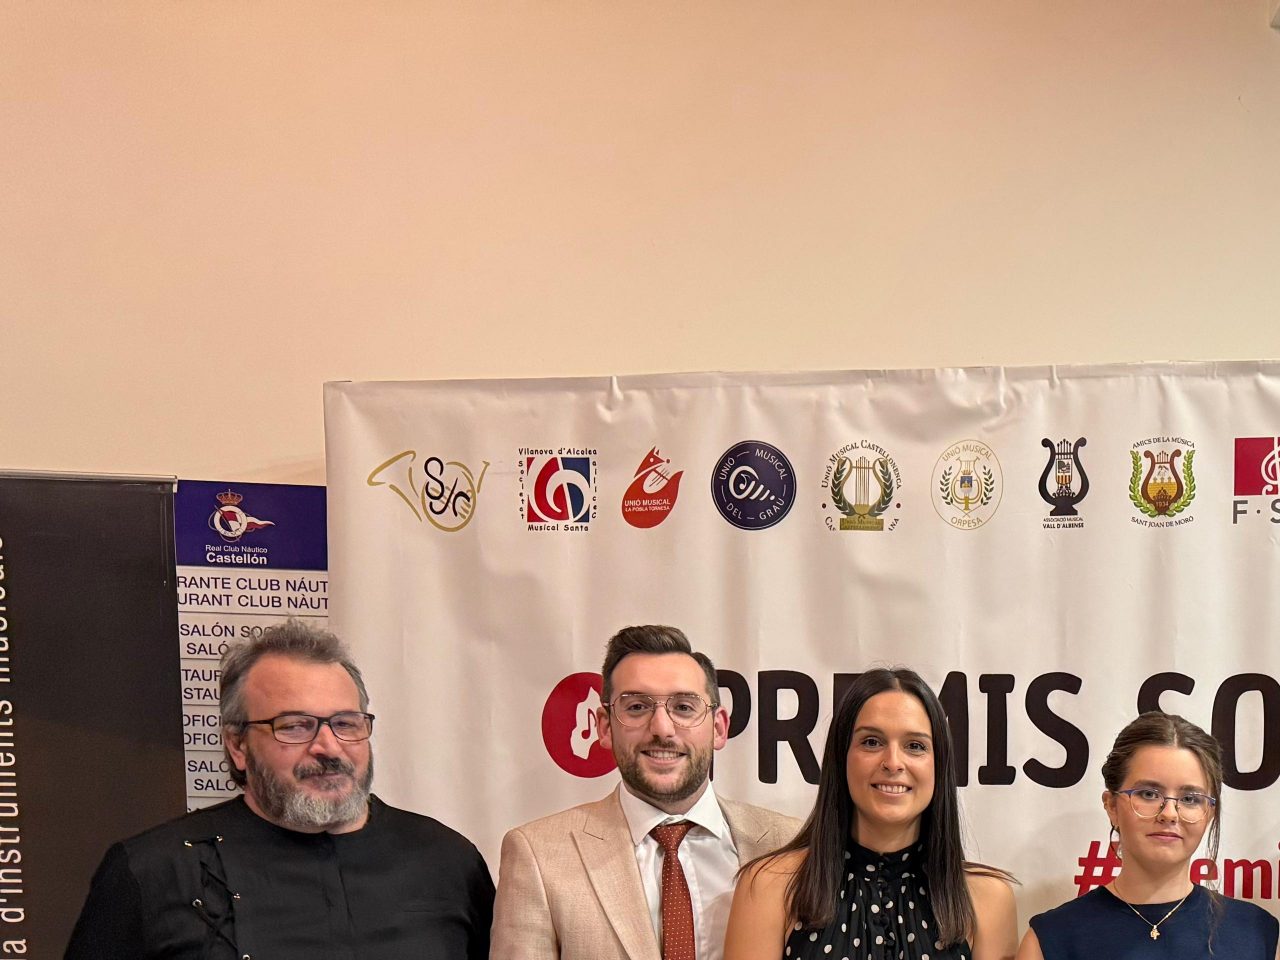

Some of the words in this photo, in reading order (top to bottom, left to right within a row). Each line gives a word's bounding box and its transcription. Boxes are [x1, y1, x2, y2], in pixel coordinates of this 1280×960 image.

[1132, 437, 1152, 449] AMICS
[518, 448, 554, 456] Vilanova
[557, 447, 597, 456] d'Alcolea
[962, 445, 993, 460] MUSICAL
[719, 456, 735, 480] UNIÓ
[754, 448, 789, 480] MUSICAL
[624, 498, 641, 506] UNIÓ
[642, 498, 671, 506] MUSICAL
[726, 502, 743, 520] DEL
[759, 498, 785, 520] GRAU
[527, 523, 559, 531] Musical
[563, 524, 589, 532] Santa
[950, 516, 983, 528] ORPESA
[1130, 516, 1148, 527] SANT
[205, 544, 222, 552] Real
[223, 545, 240, 553] Club
[241, 545, 268, 554] Náutico
[206, 552, 268, 565] Castellón
[236, 577, 281, 591] CLUB
[285, 577, 328, 593] NÁUT
[237, 594, 282, 608] CLUB
[179, 621, 235, 637] SALÓN
[709, 668, 1090, 788] PRIS
